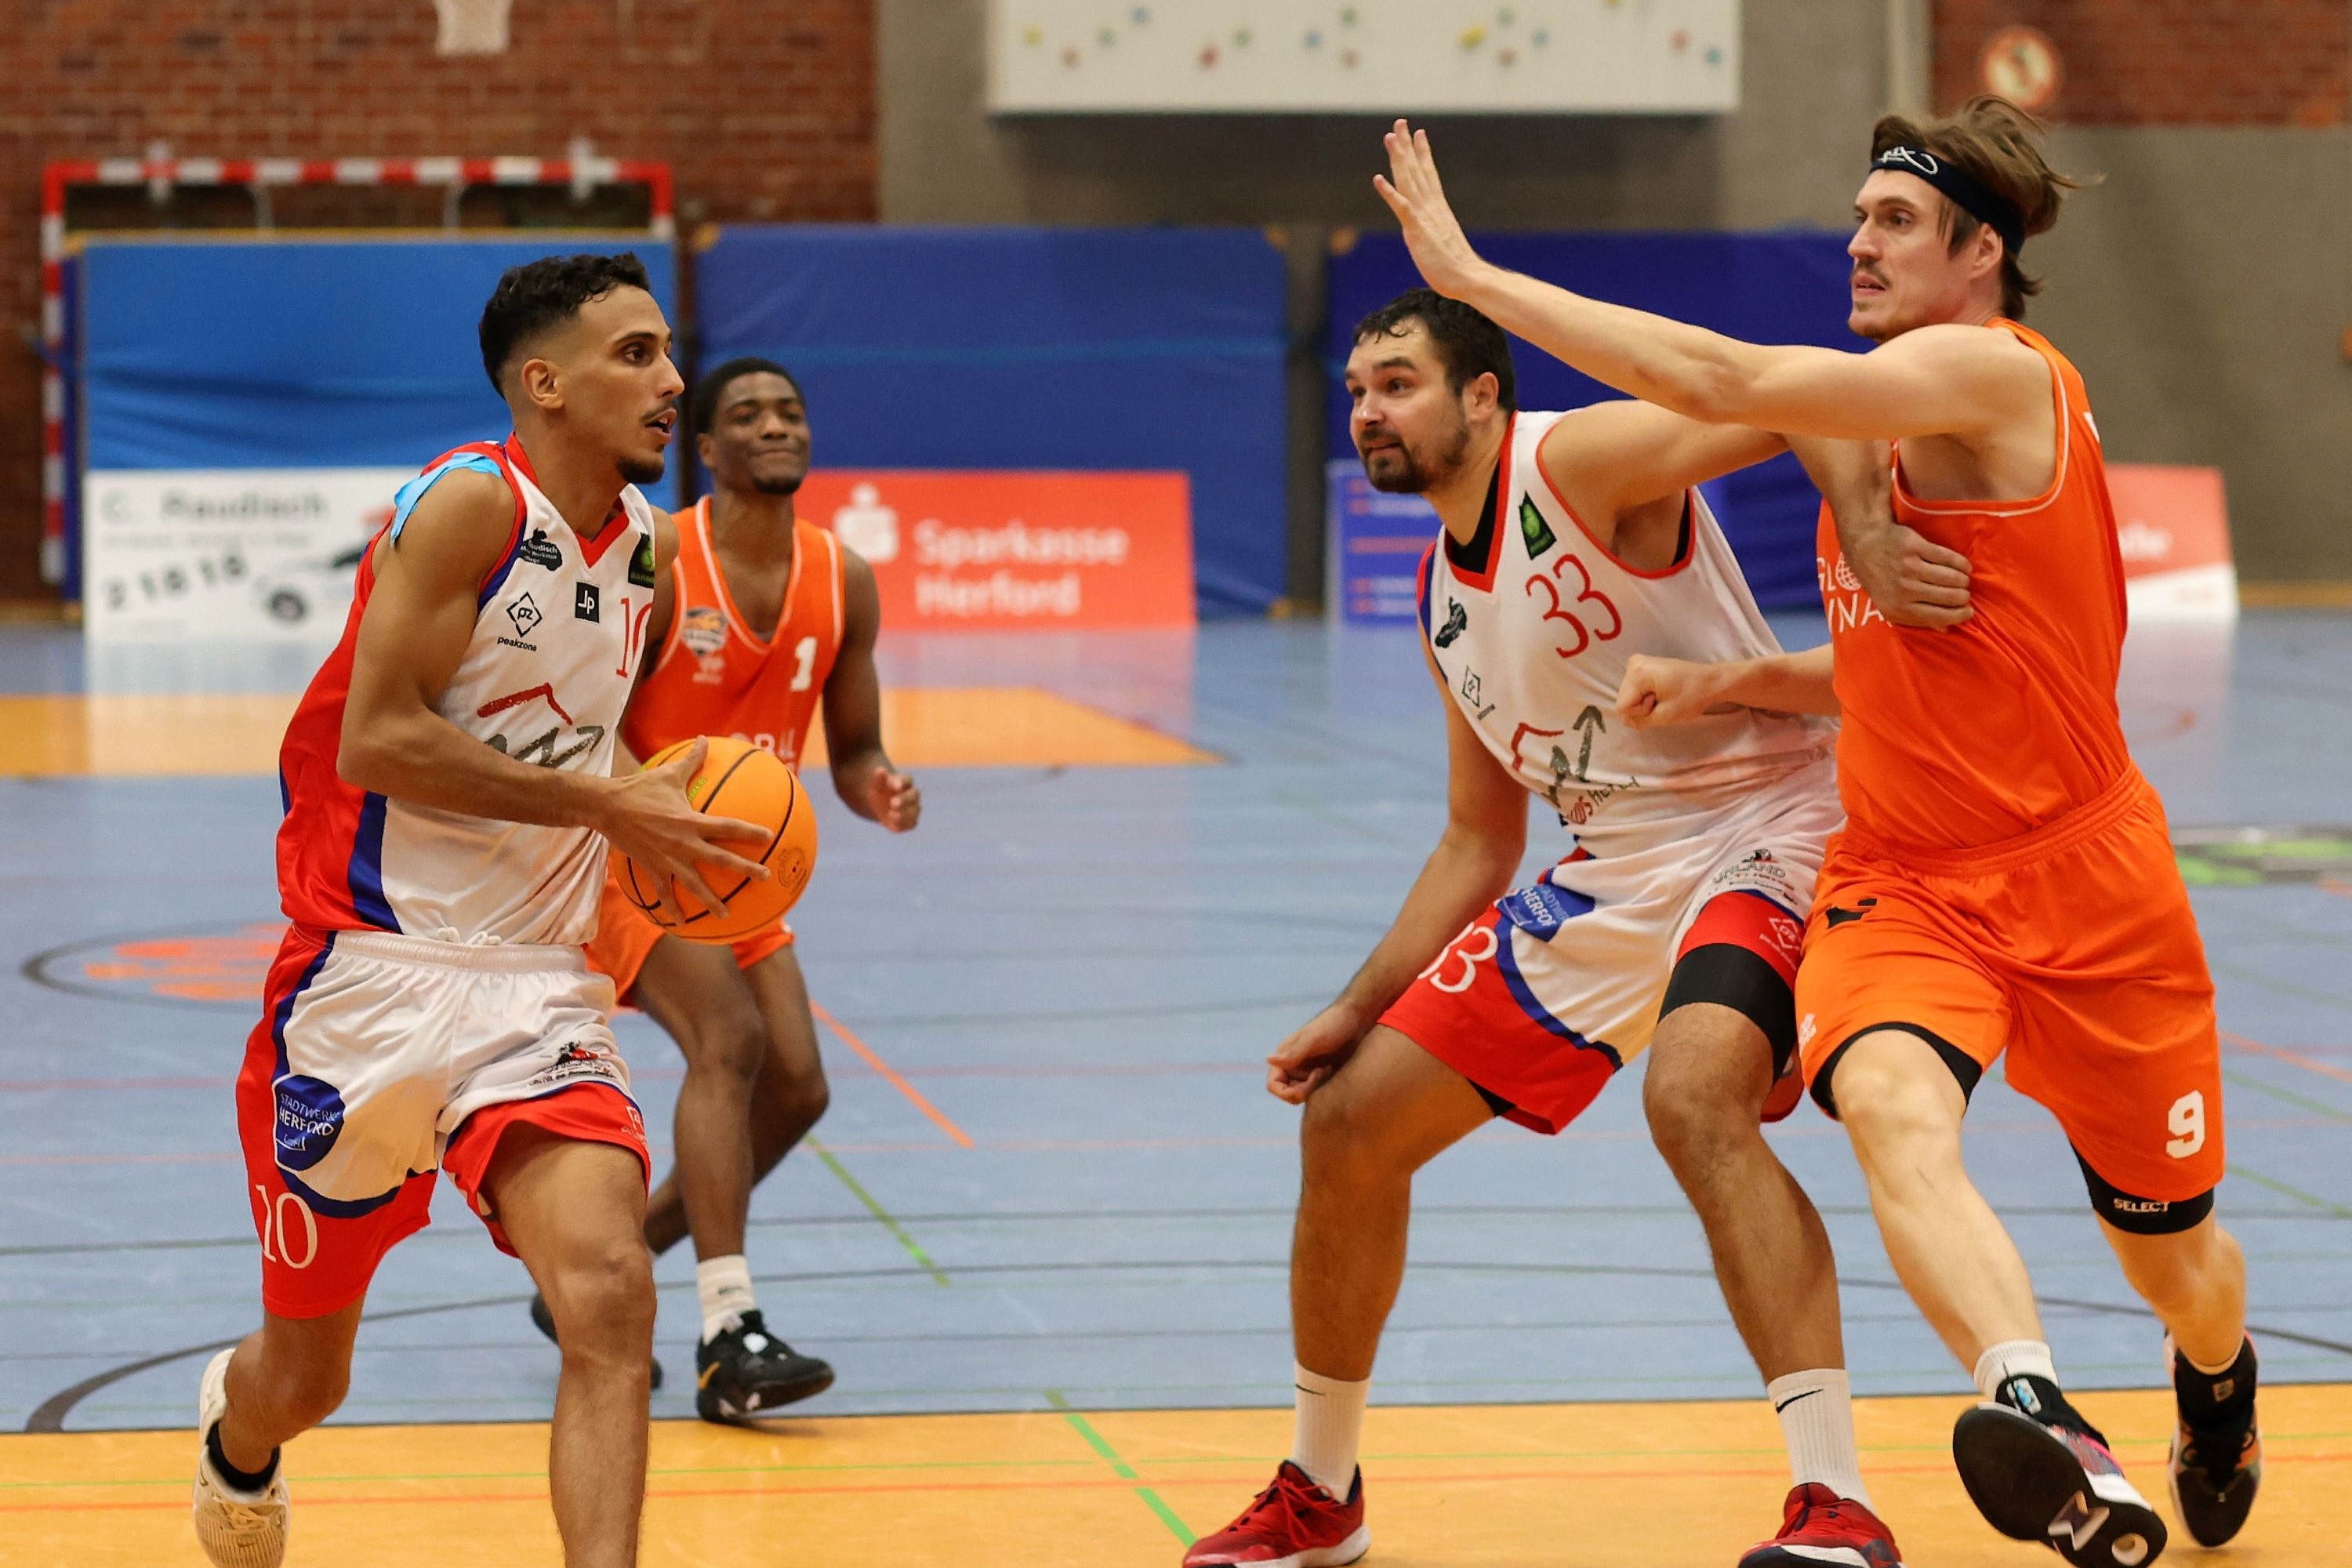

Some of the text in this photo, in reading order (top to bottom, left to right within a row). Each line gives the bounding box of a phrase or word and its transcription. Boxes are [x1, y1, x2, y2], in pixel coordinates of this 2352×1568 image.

[912, 518, 1129, 571] Sparkasse
[915, 568, 1081, 617] Herford
[1526, 554, 1621, 659] 33
[497, 637, 538, 652] peakzone
[789, 636, 817, 691] 1
[280, 1106, 334, 1136] HERFORD
[2166, 1090, 2206, 1159] 9
[256, 1184, 318, 1269] 10
[2114, 1198, 2170, 1213] SELECT
